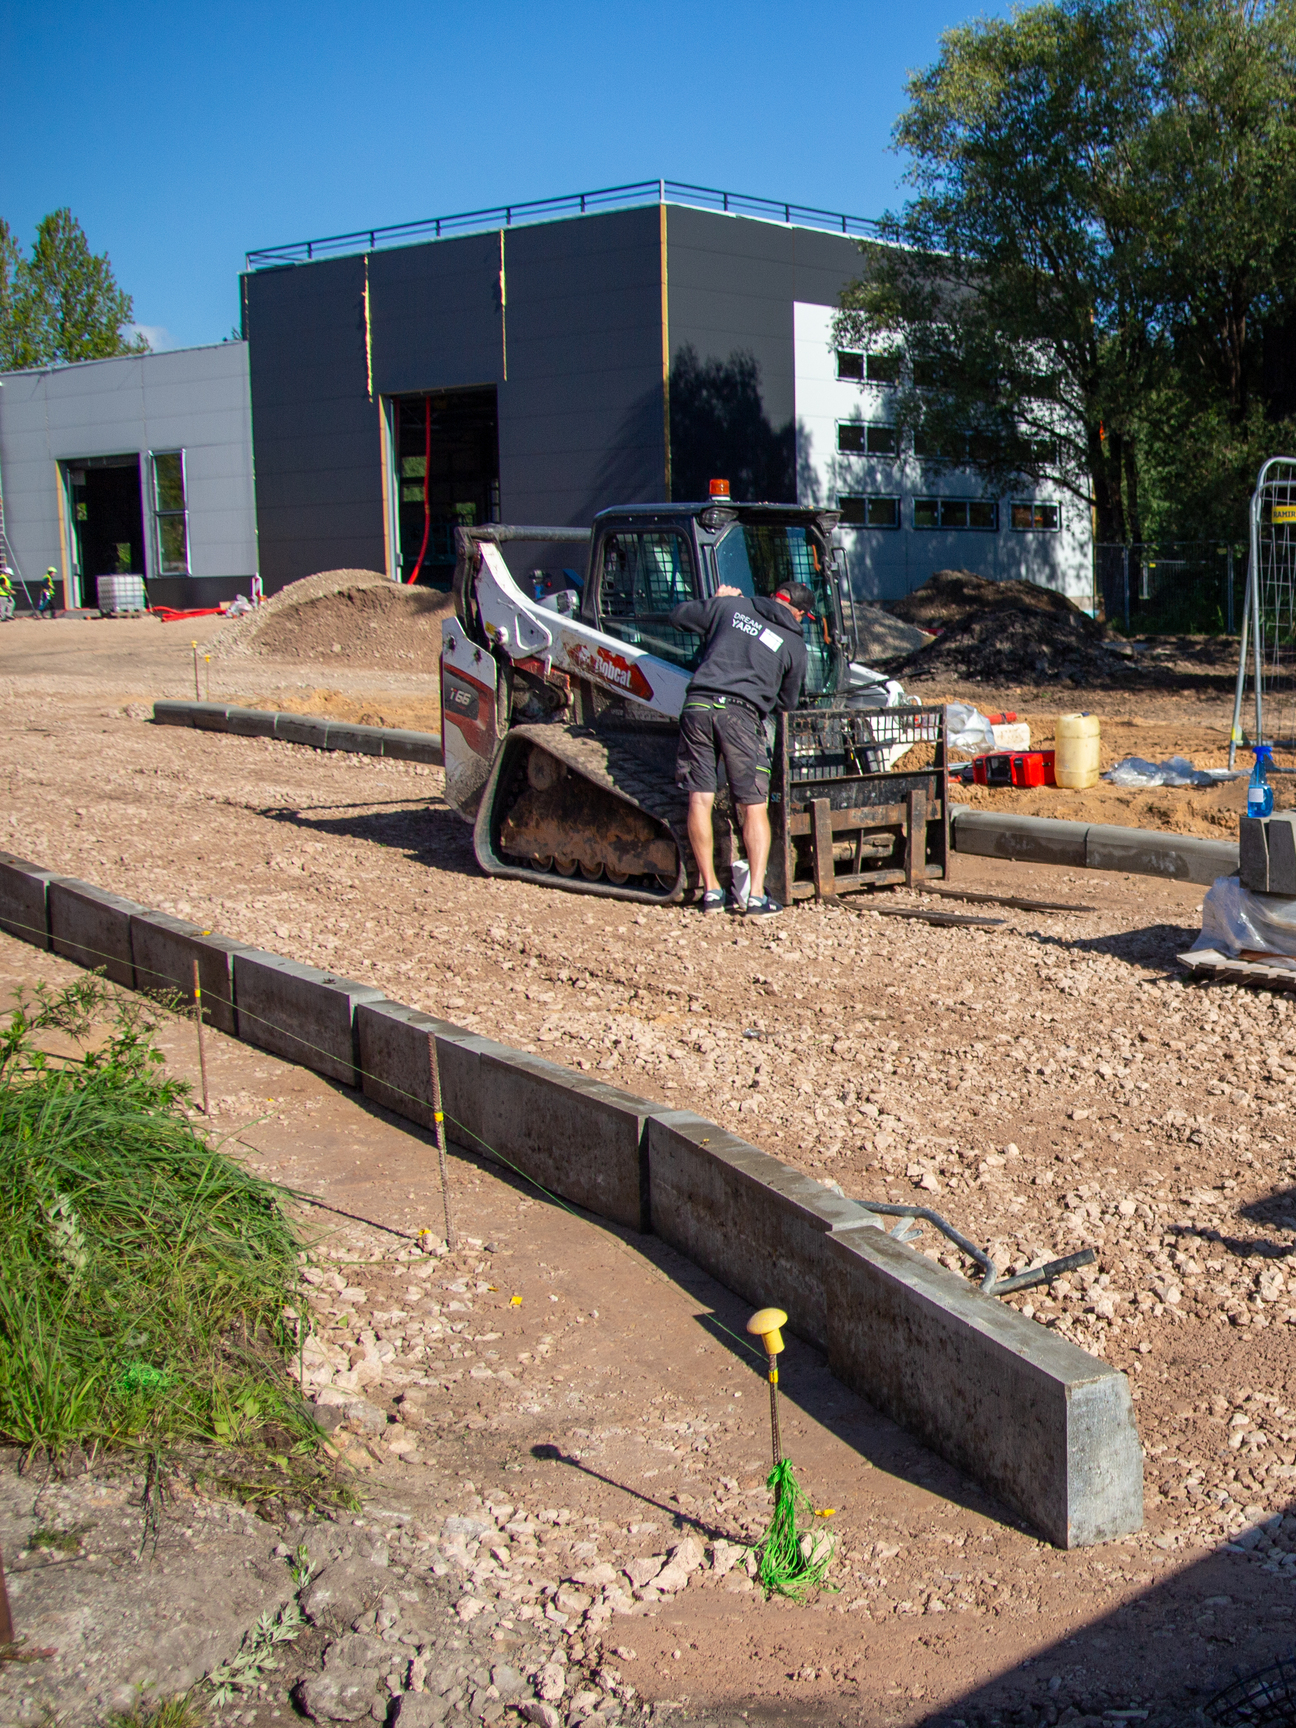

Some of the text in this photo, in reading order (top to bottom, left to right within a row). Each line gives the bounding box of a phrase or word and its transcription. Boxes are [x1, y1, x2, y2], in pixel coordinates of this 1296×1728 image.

[731, 618, 759, 637] YARD
[733, 612, 763, 631] DREAM
[595, 656, 632, 688] Bobcat
[450, 688, 471, 706] T66
